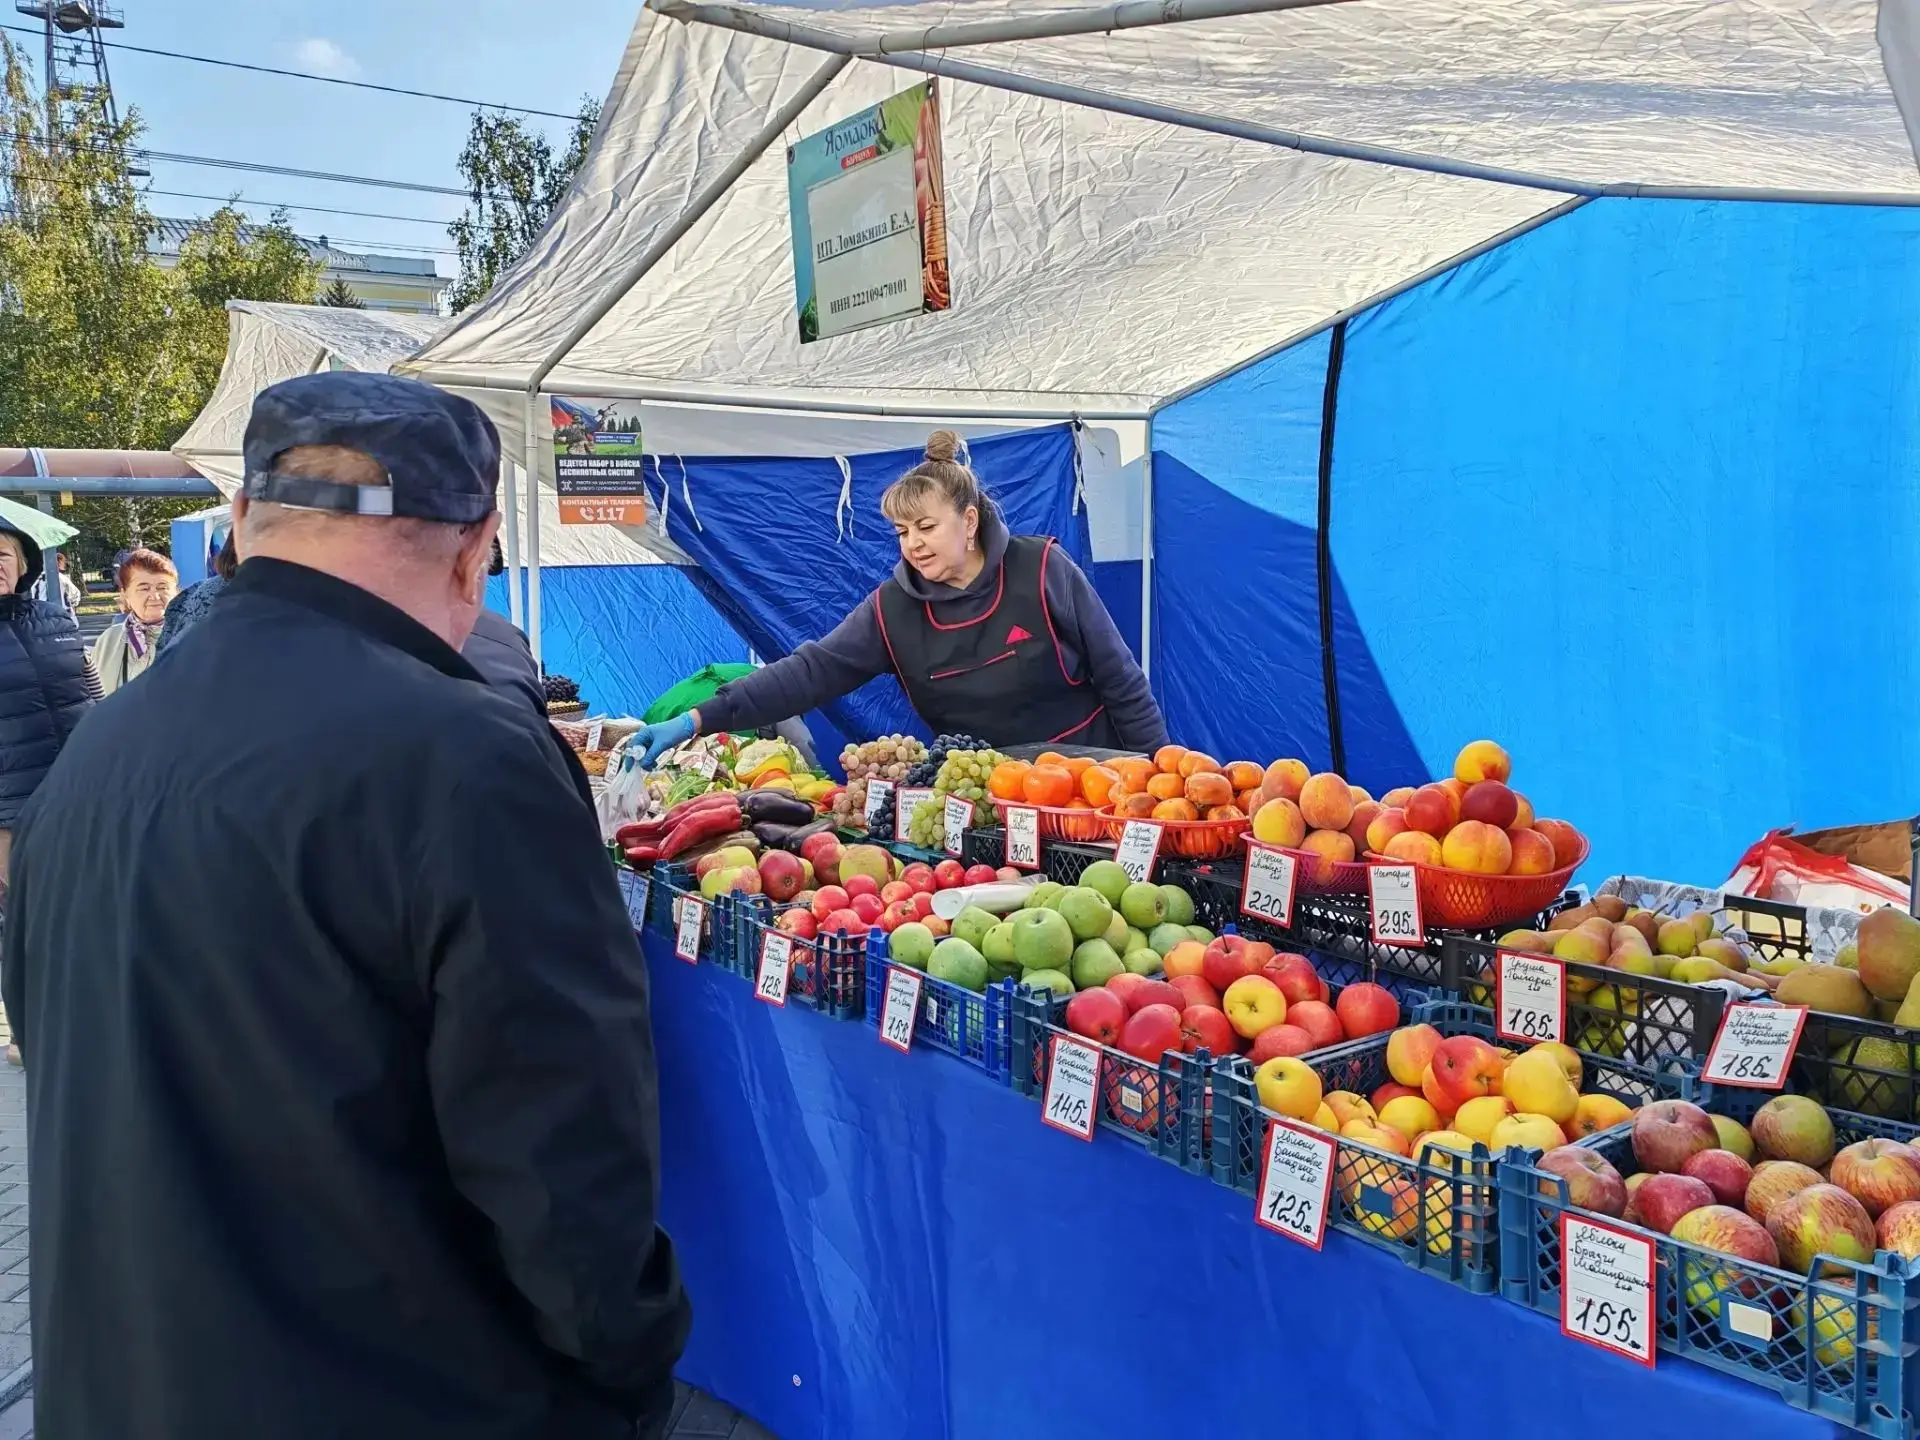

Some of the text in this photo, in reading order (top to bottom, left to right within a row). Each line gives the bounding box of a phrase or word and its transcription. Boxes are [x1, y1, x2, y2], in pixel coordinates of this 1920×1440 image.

[825, 106, 886, 160] Ярмарка
[817, 210, 915, 259] ИП Ломакина Е.А.
[830, 278, 907, 314] ИНН 222109470101
[559, 468, 635, 476] БЕСПИЛОТНЫХ СИСТЕМ!
[589, 459, 609, 468] НАБОР
[610, 460, 615, 468] В
[616, 458, 641, 468] ВОЙСКА
[610, 498, 643, 506] ТЕЛЕФОН:
[596, 507, 625, 521] 117
[1276, 1130, 1315, 1151] Яблоки
[1575, 1226, 1627, 1253] Яблоки
